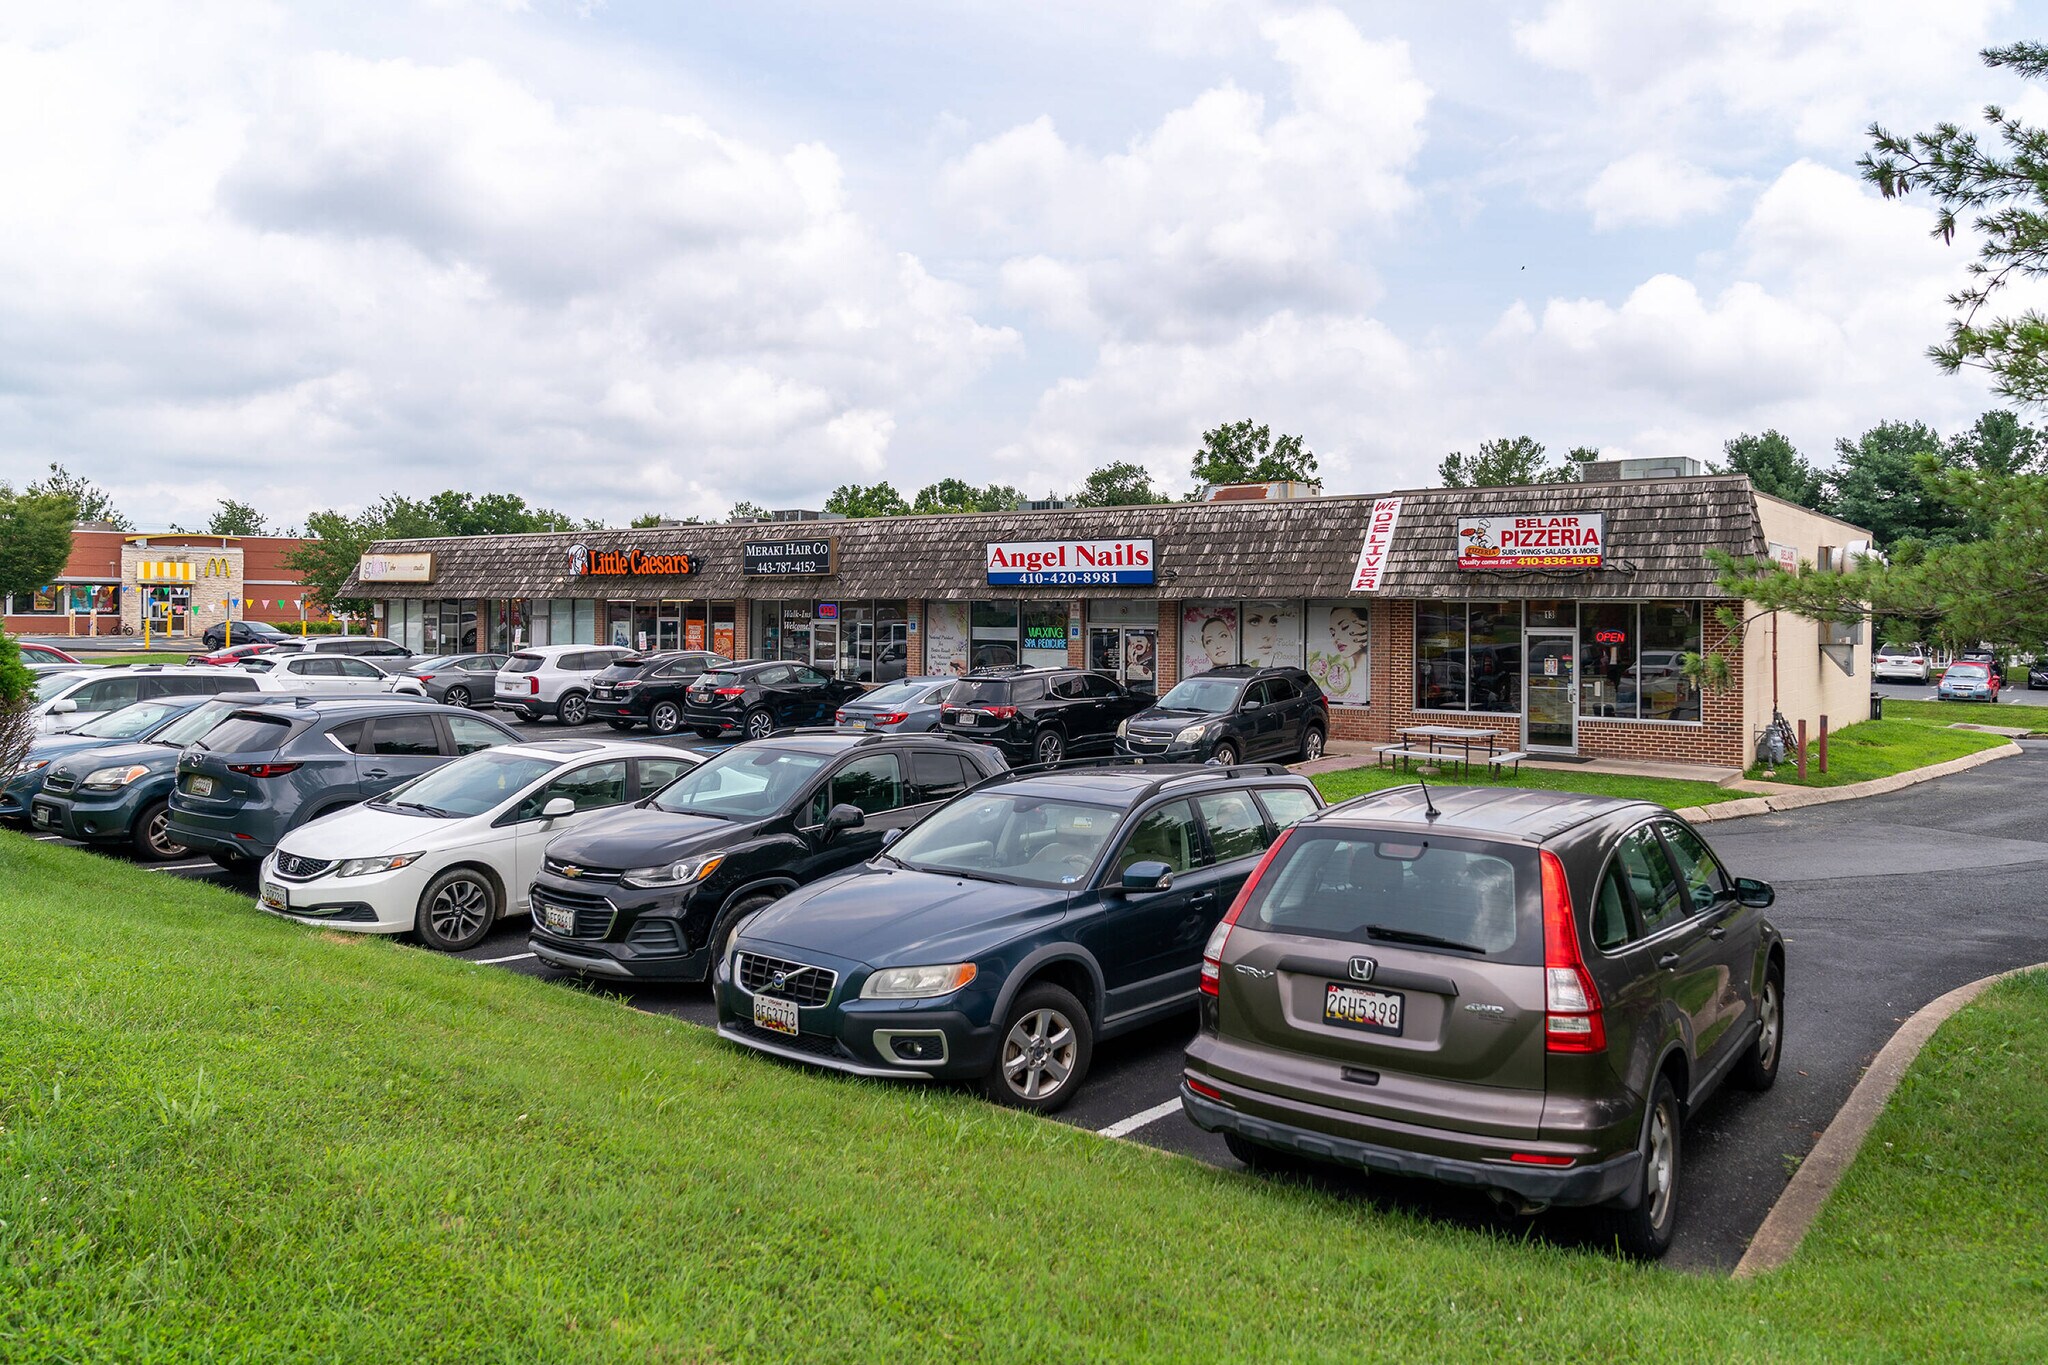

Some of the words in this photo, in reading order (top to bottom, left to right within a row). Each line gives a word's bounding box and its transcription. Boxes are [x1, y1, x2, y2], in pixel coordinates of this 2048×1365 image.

[1375, 501, 1400, 511] WE
[1515, 518, 1579, 528] BELAIR
[1501, 528, 1600, 547] PIZZERIA
[785, 543, 811, 555] HAIR
[1356, 513, 1393, 588] DELIVER
[589, 549, 628, 575] Little
[630, 549, 689, 574] Caesars
[989, 546, 1065, 571] Angel
[1075, 543, 1149, 566] Nails
[1516, 556, 1599, 565] 410-836-1313
[756, 561, 816, 573] 443-787-4152
[1019, 572, 1118, 584] 410-420-8981
[1027, 627, 1064, 639] WAXING
[1596, 632, 1625, 642] OPEN
[1024, 638, 1036, 648] SPA
[1037, 638, 1067, 649] PEDICURE
[1234, 964, 1274, 978] CR-V
[1327, 993, 1398, 1025] 2GH5398
[1464, 1002, 1505, 1014] 4WD
